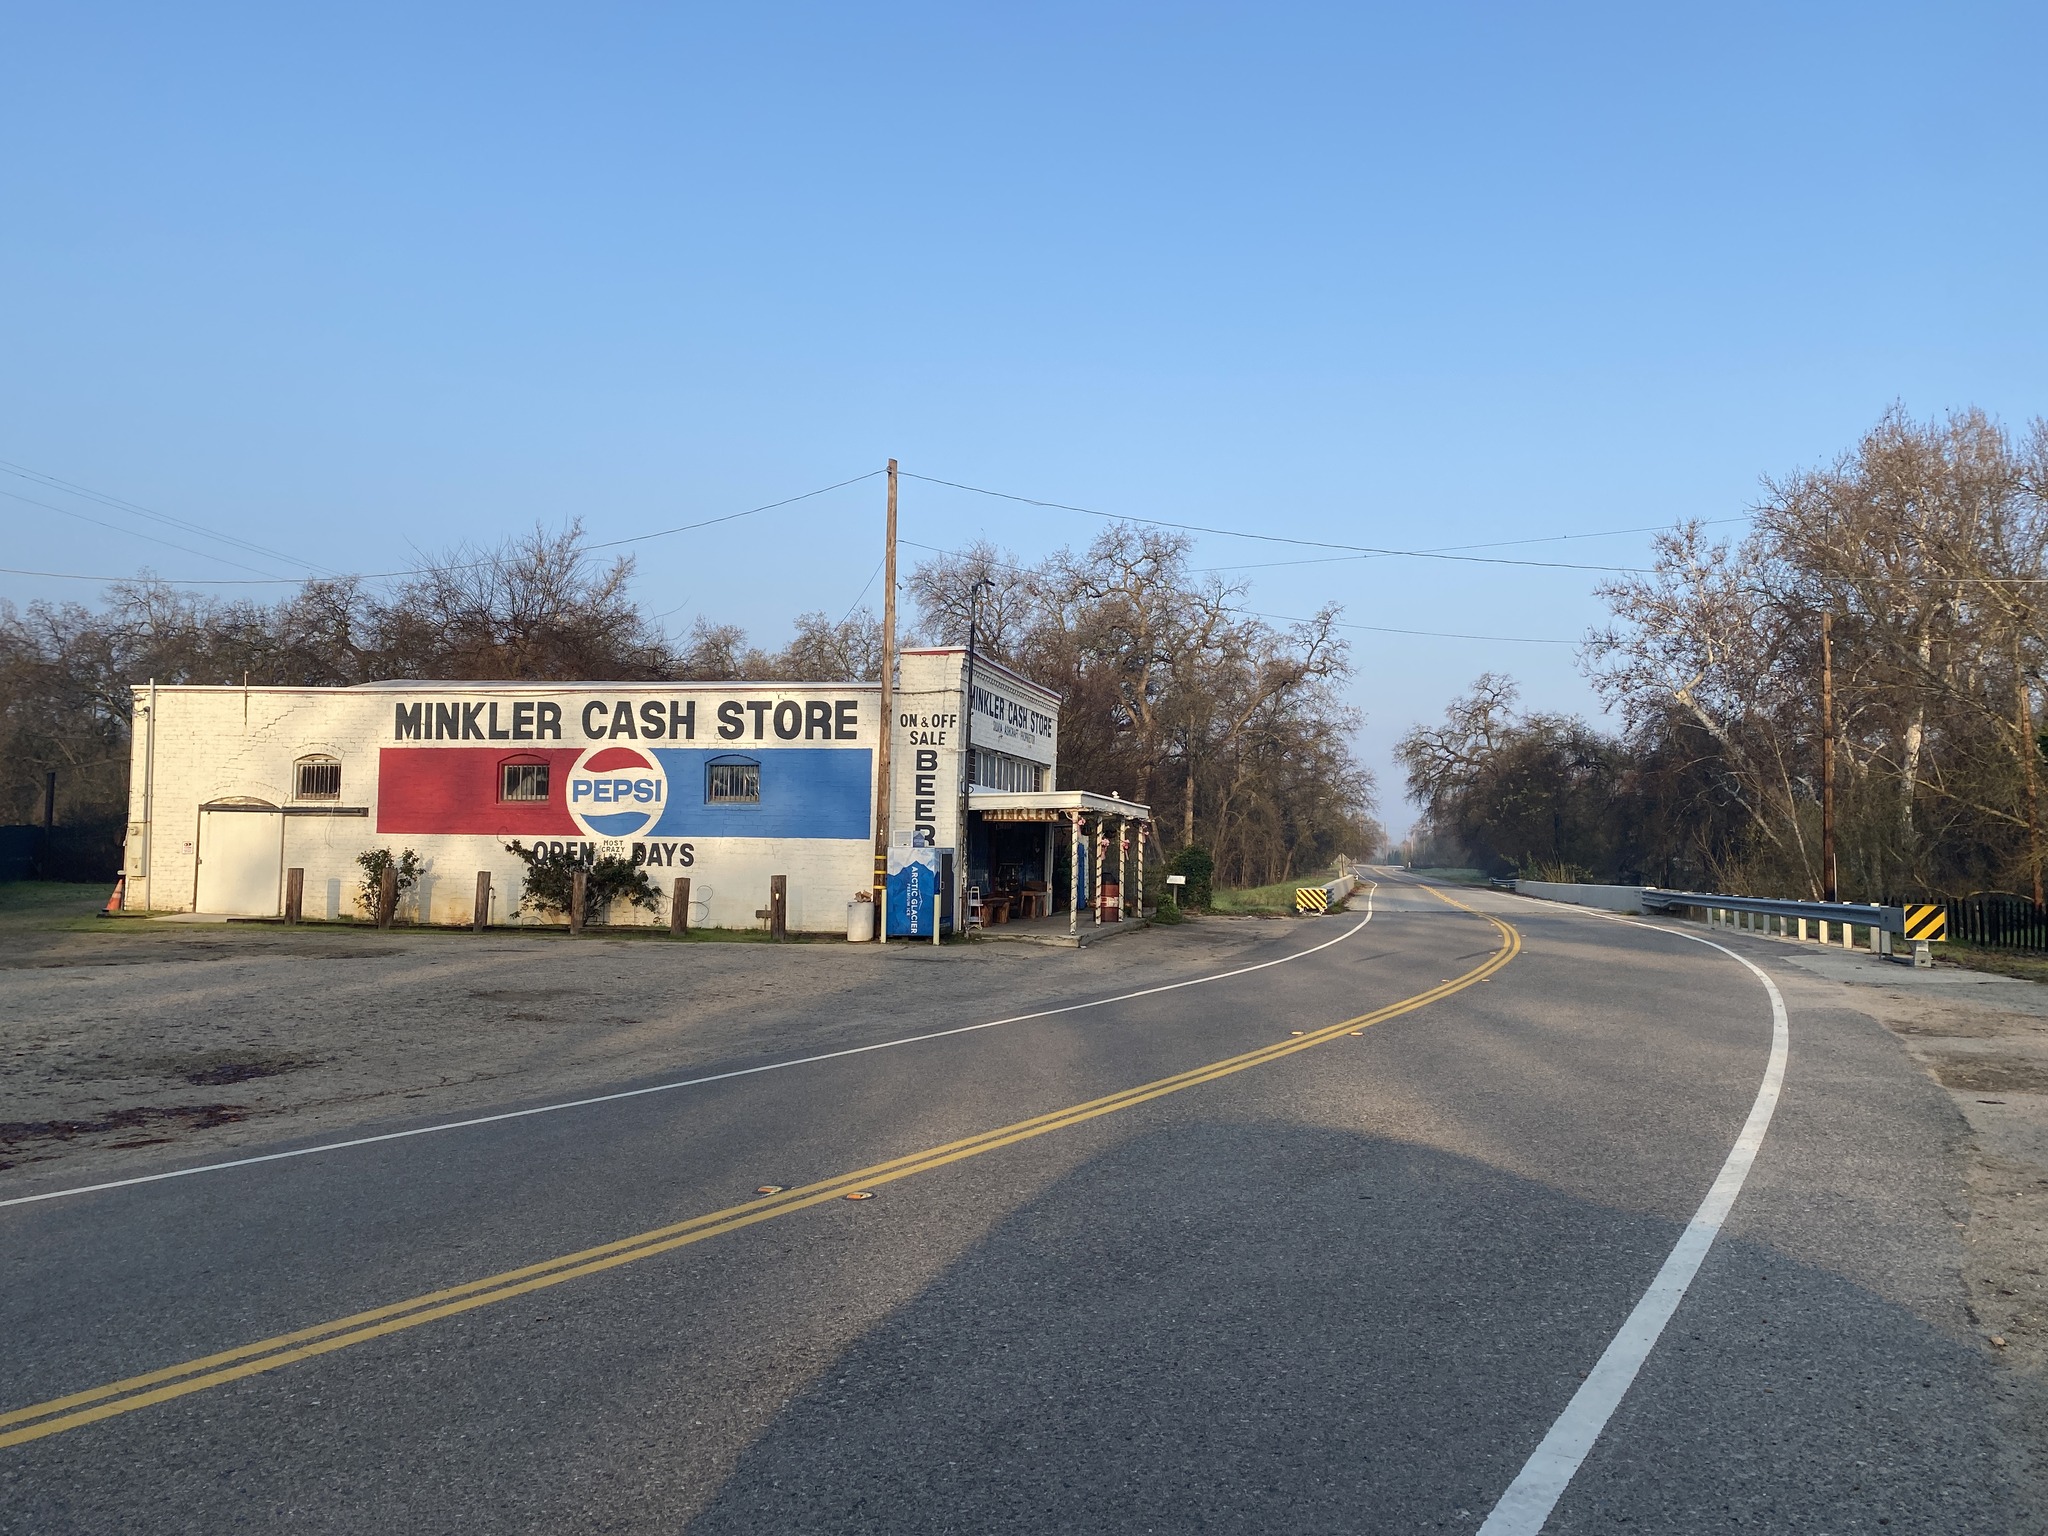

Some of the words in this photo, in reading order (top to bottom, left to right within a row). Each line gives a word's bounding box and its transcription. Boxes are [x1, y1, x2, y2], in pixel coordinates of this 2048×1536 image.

[395, 702, 562, 740] MINKLER
[581, 700, 695, 740] CASH
[717, 700, 858, 740] STORE
[900, 714, 918, 728] ON
[920, 716, 929, 728] &
[931, 714, 957, 728] OFF
[1008, 701, 1028, 730] CASH
[1030, 710, 1052, 738] STORE
[909, 730, 947, 746] SALE
[572, 779, 662, 803] PEPSI
[915, 749, 938, 846] BEER
[533, 841, 594, 866] OPEN
[631, 842, 695, 867] DAYS
